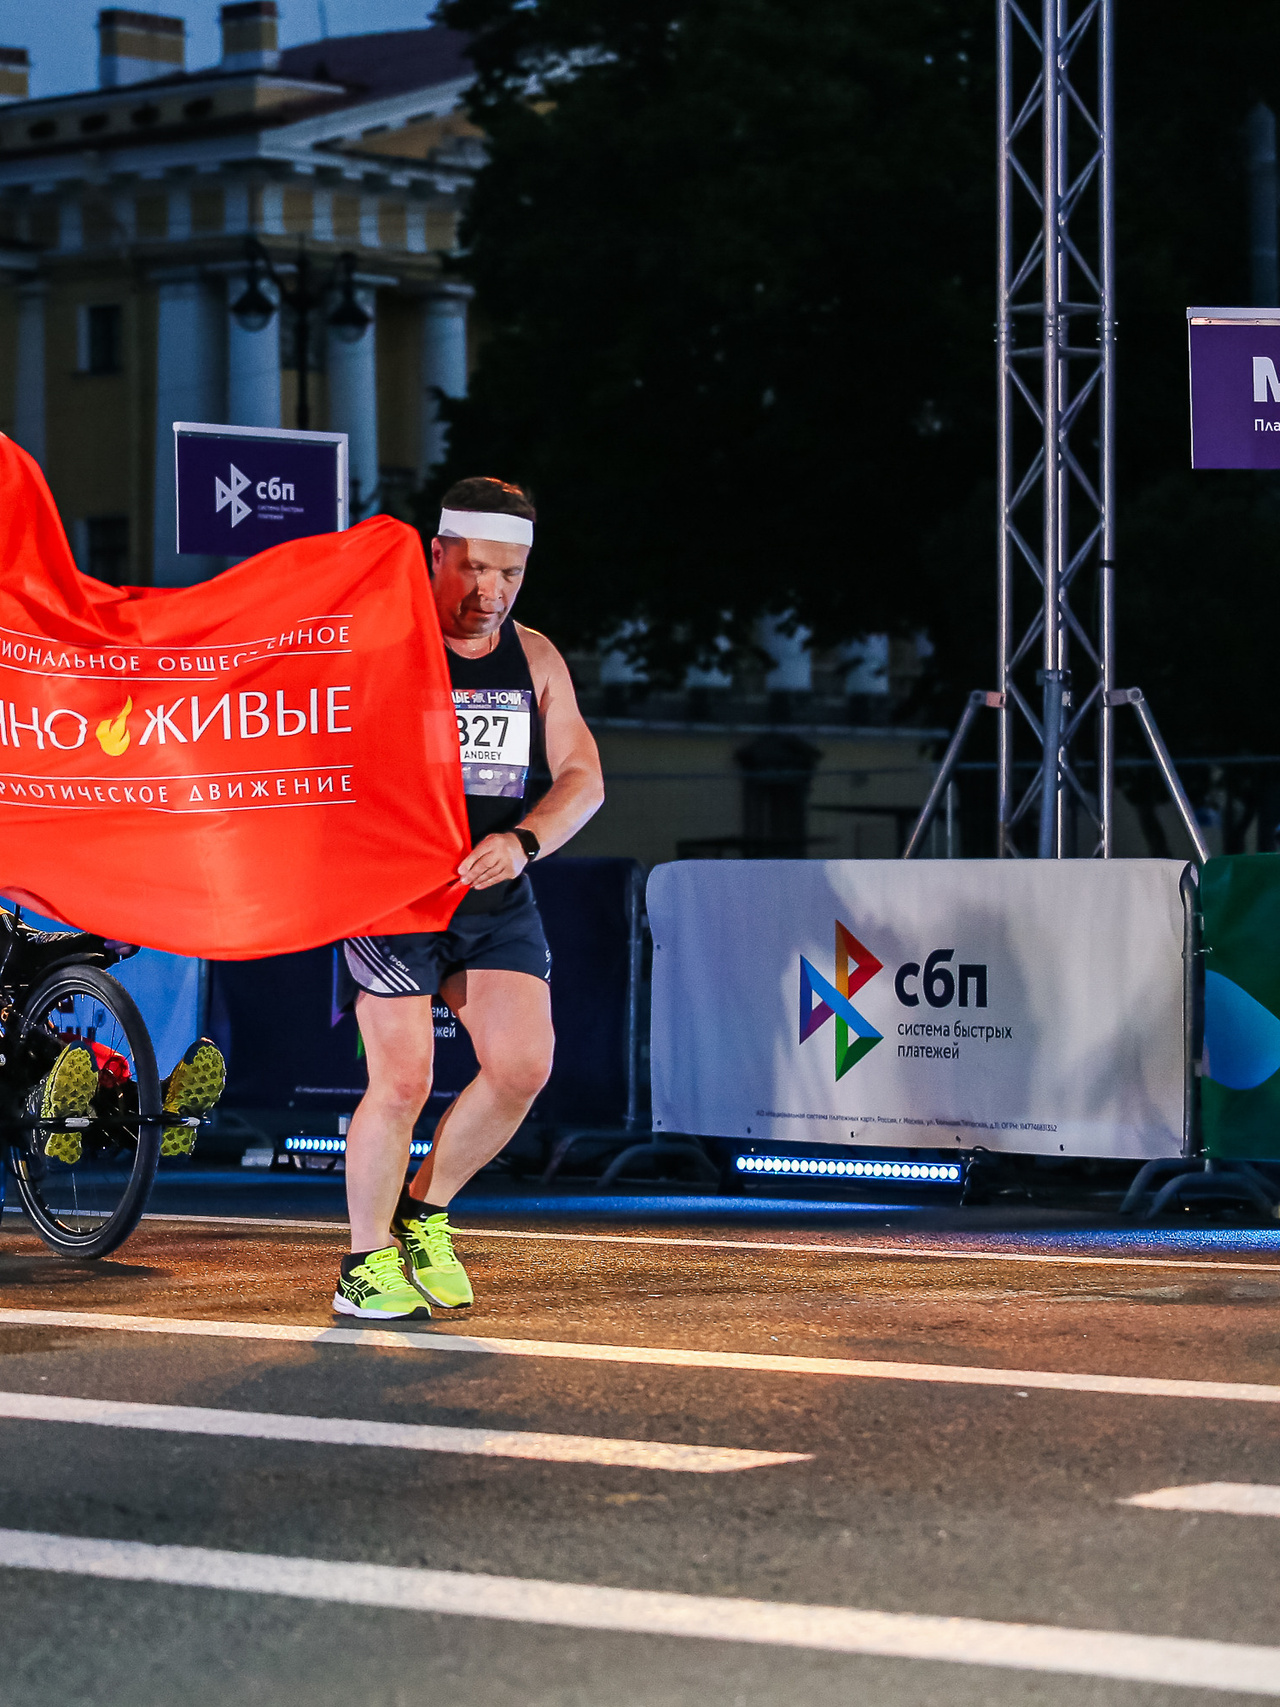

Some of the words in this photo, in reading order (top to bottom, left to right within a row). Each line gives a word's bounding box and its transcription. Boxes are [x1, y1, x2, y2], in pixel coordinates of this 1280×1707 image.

[256, 476, 295, 501] сбп
[138, 685, 353, 746] ЖИВЫЕ
[464, 750, 502, 761] ANDREY
[189, 773, 353, 803] ДВИЖЕНИЕ
[894, 948, 988, 1009] сбп
[897, 1023, 950, 1037] система
[953, 1020, 1013, 1043] быстрых
[897, 1041, 960, 1059] платежей
